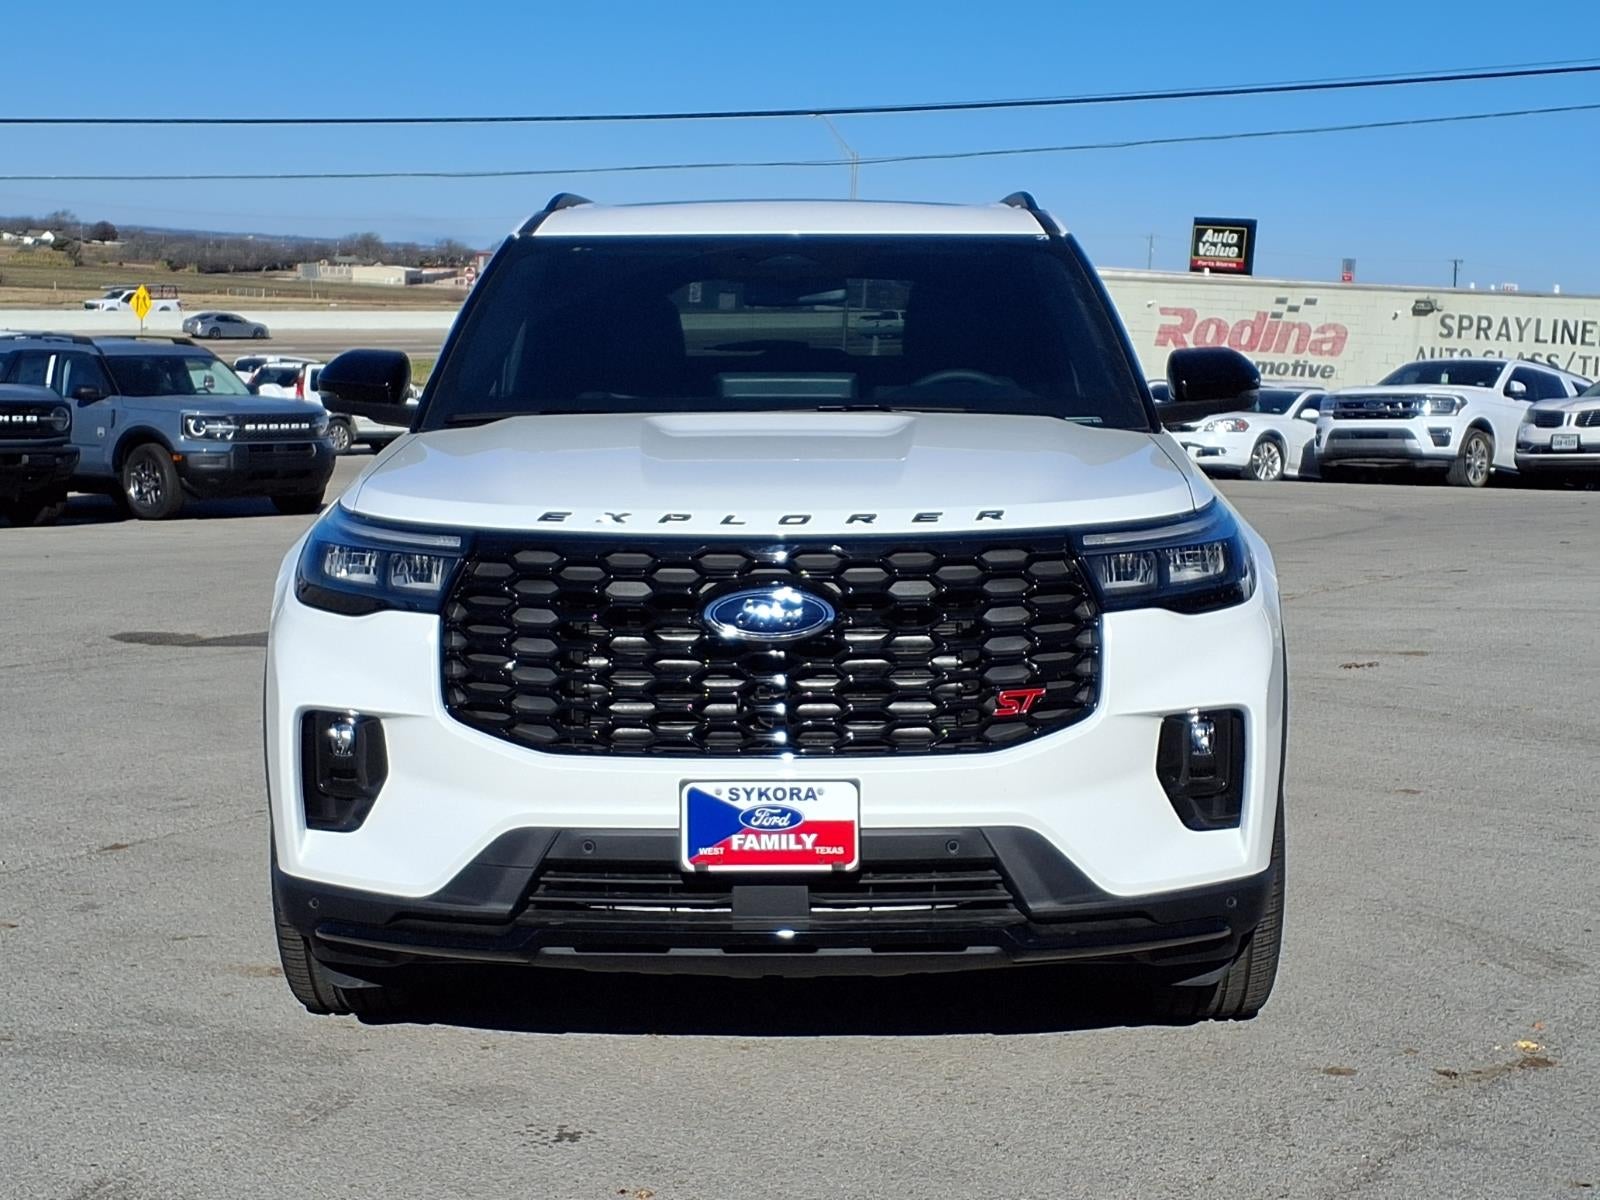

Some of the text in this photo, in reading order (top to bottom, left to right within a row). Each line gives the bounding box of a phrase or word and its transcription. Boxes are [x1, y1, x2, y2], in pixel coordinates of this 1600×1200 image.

[1201, 228, 1239, 244] Auto
[1198, 241, 1239, 257] Value
[1154, 307, 1349, 357] Rodina
[1438, 313, 1600, 347] SPRAYLINE
[1256, 360, 1335, 379] motive
[537, 509, 1005, 526] EXPLORER
[991, 688, 1047, 717] ST
[727, 787, 818, 801] SYKORA
[750, 806, 791, 827] Ford
[699, 846, 845, 855] WEST TEXAS
[731, 833, 818, 851] FAMILY
